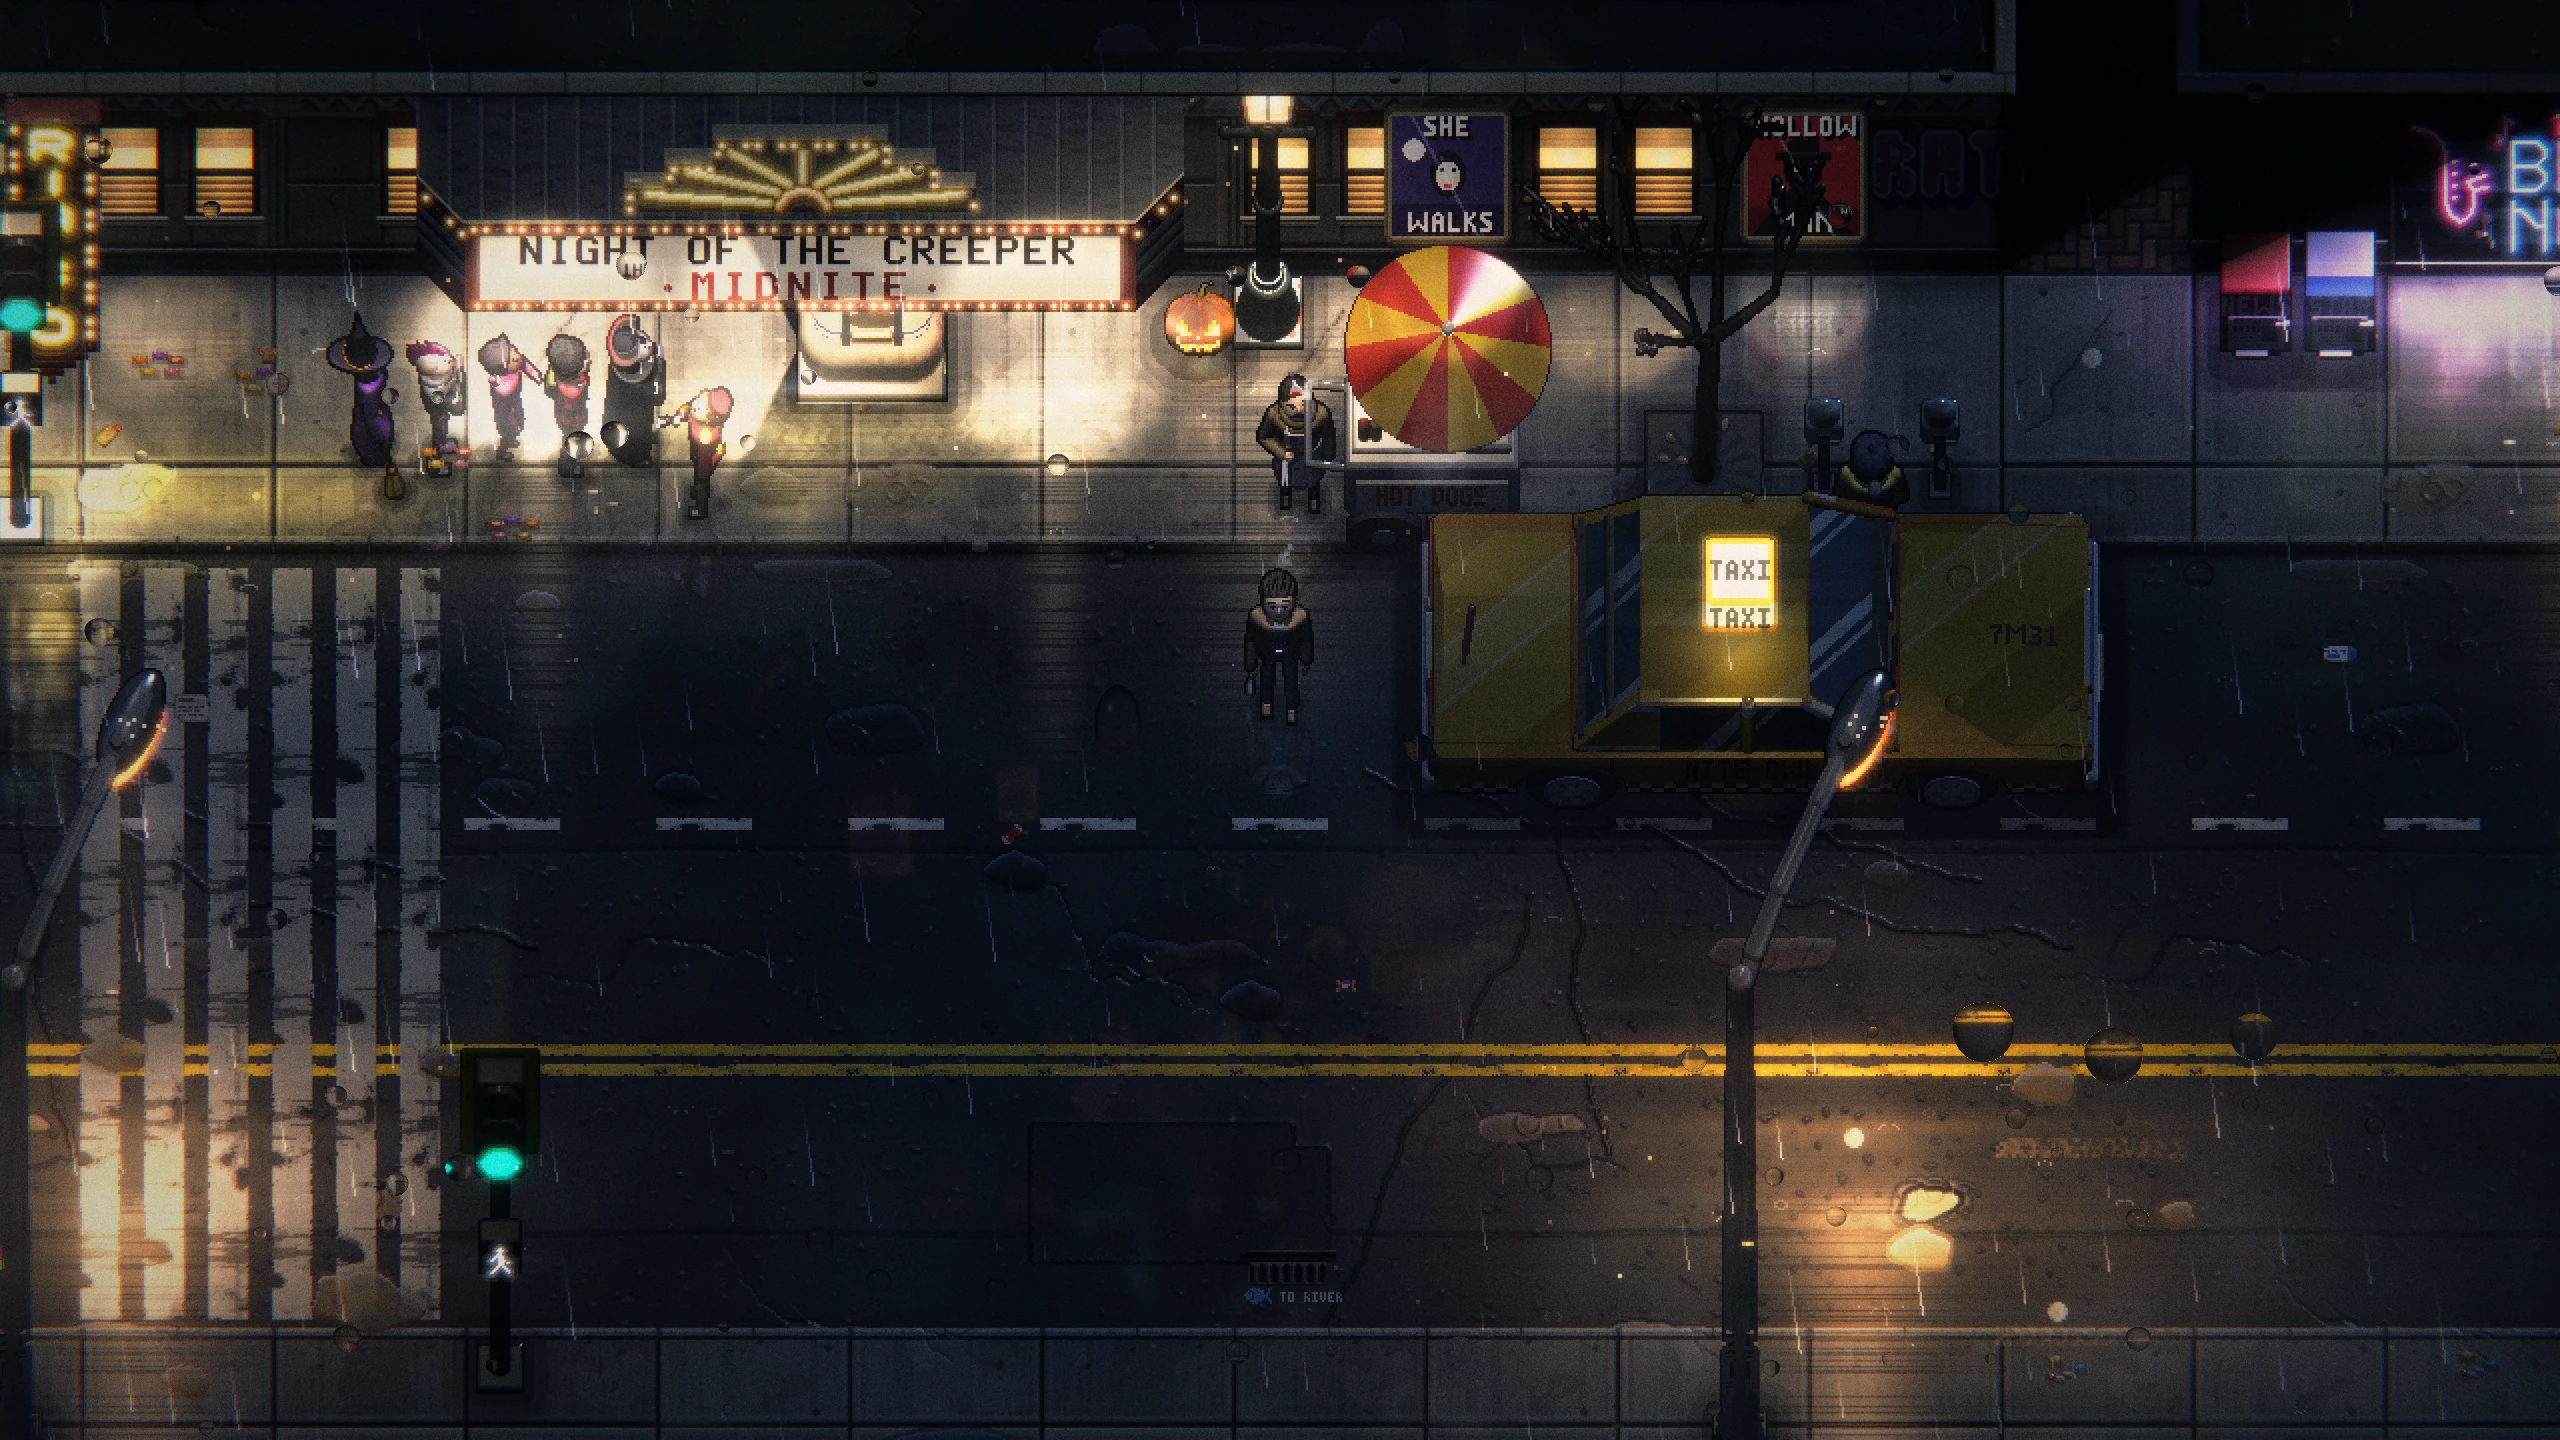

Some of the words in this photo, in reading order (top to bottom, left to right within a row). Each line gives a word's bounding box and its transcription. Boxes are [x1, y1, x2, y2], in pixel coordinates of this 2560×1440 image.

[1423, 115, 1469, 137] SHE
[1407, 211, 1493, 233] WALKS
[519, 235, 654, 265] NIGHT
[687, 235, 738, 264] OF
[772, 235, 850, 265] THE
[883, 235, 1075, 265] CREEPER
[691, 271, 907, 301] MIDNITE
[1375, 485, 1417, 507] HOT
[1431, 485, 1488, 507] DOGS
[1709, 559, 1771, 581] TAXI
[1709, 607, 1771, 629] TAXI
[1989, 623, 2059, 647] 7M31
[1685, 760, 1747, 781] NITE
[1280, 1291, 1295, 1303] TO
[1303, 1291, 1343, 1303] RIVER
